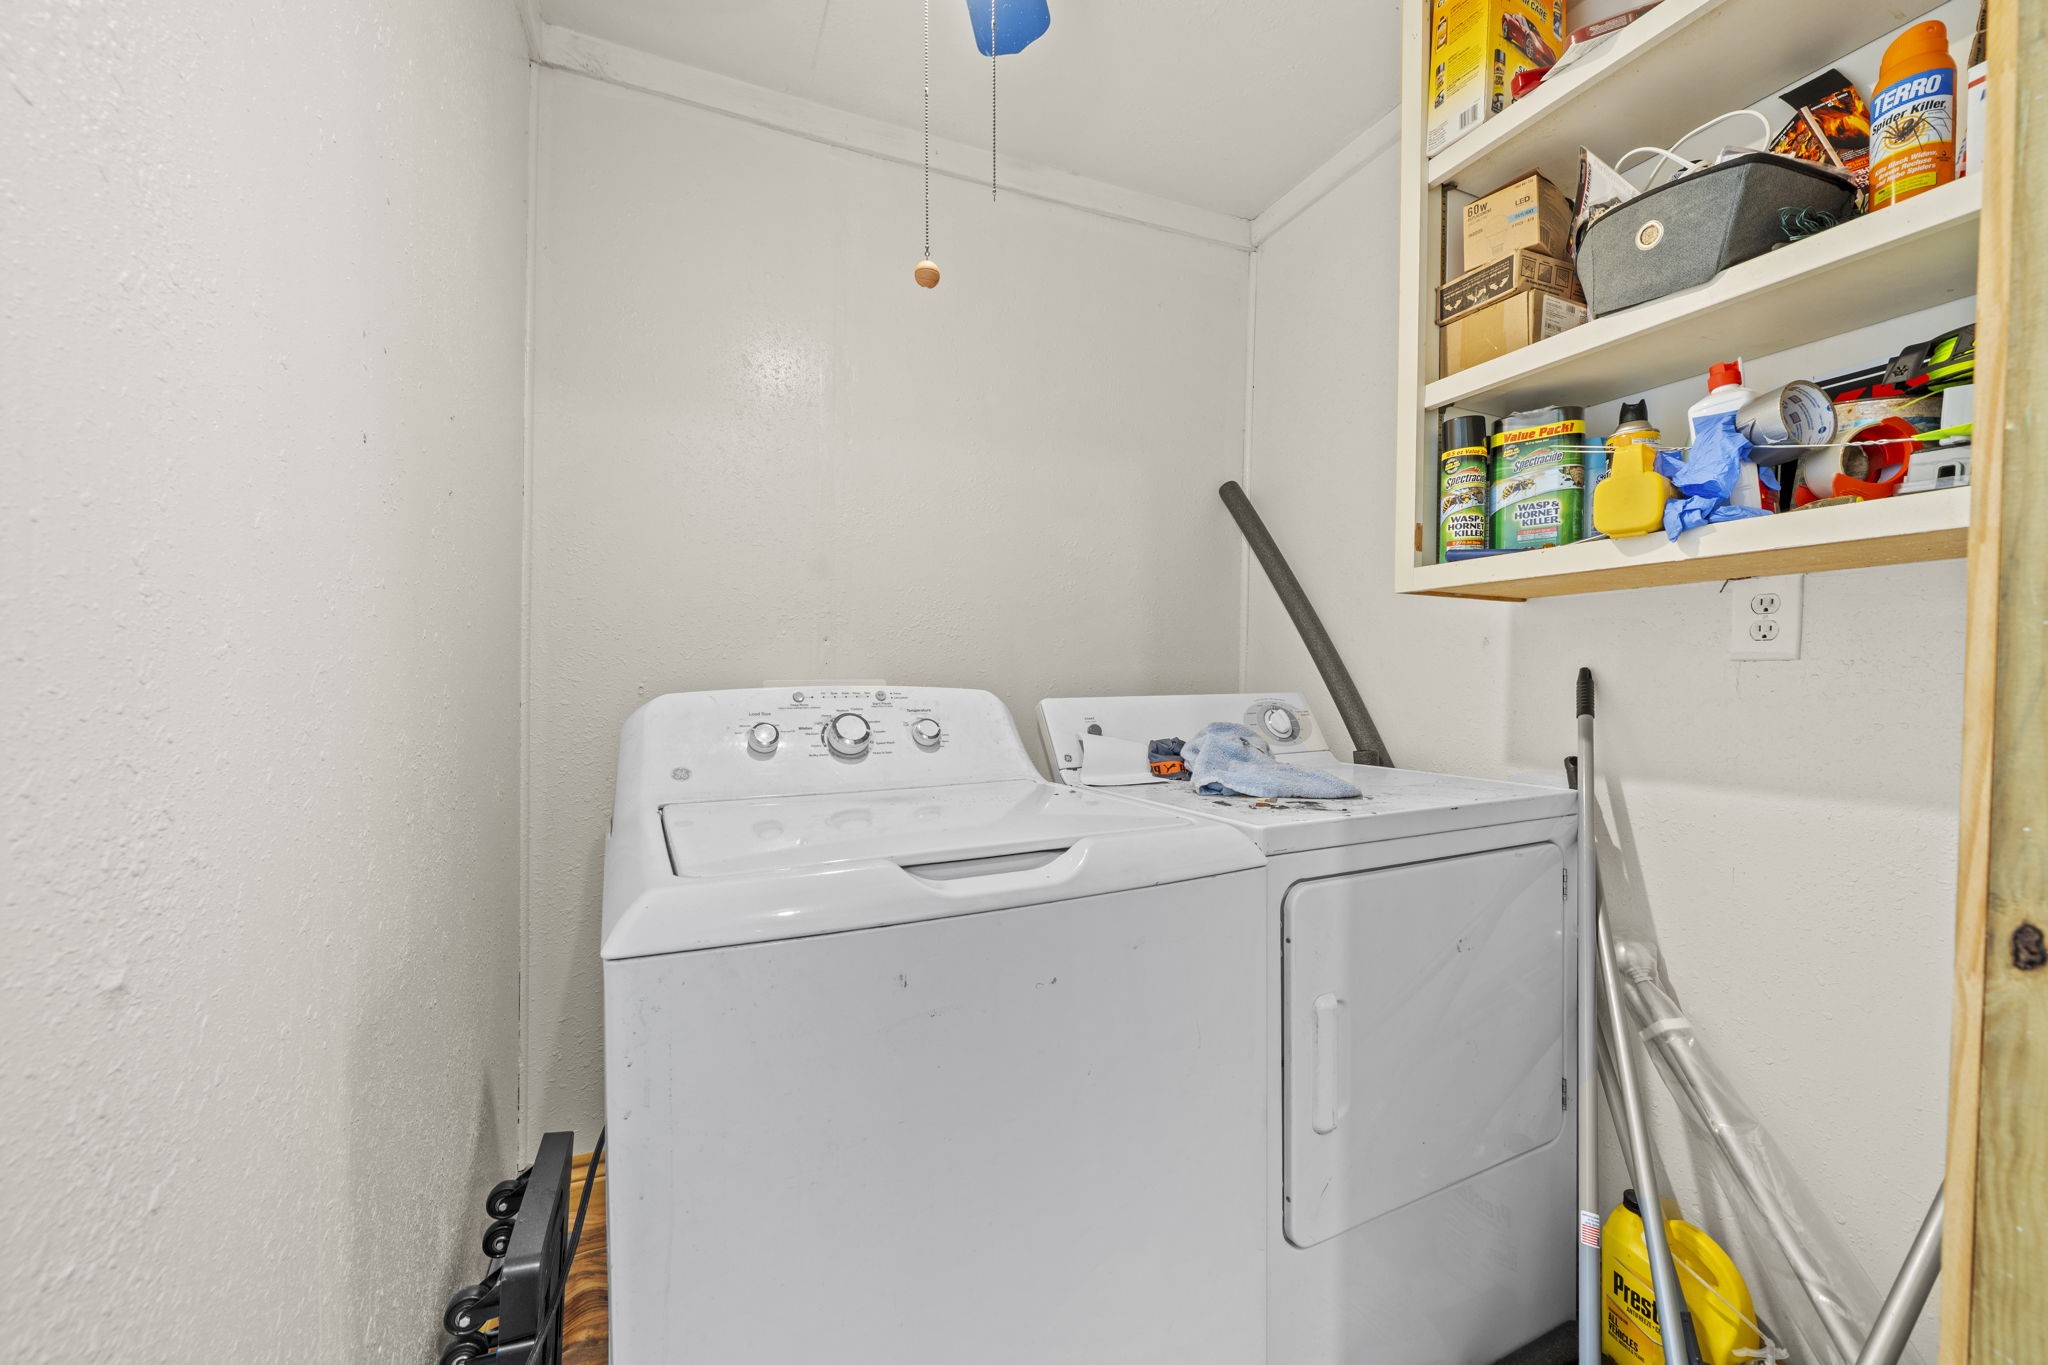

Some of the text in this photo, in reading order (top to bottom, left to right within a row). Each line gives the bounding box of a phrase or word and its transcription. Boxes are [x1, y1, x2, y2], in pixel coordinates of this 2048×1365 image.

[1874, 74, 1942, 118] TERRO
[1872, 110, 1907, 136] Spider
[1515, 195, 1531, 206] LED
[1503, 431, 1536, 443] Value
[1538, 422, 1575, 437] Pack!
[1513, 451, 1563, 473] Spectracide
[1517, 500, 1550, 511] WASP
[1451, 515, 1480, 523] WASP
[1514, 508, 1561, 520] HORNET
[1447, 522, 1485, 531] HORNET
[1521, 516, 1560, 527] KILLER
[1454, 530, 1485, 538] KILLER
[1608, 1311, 1619, 1327] ALL
[1608, 1320, 1639, 1353] VEHICLES
